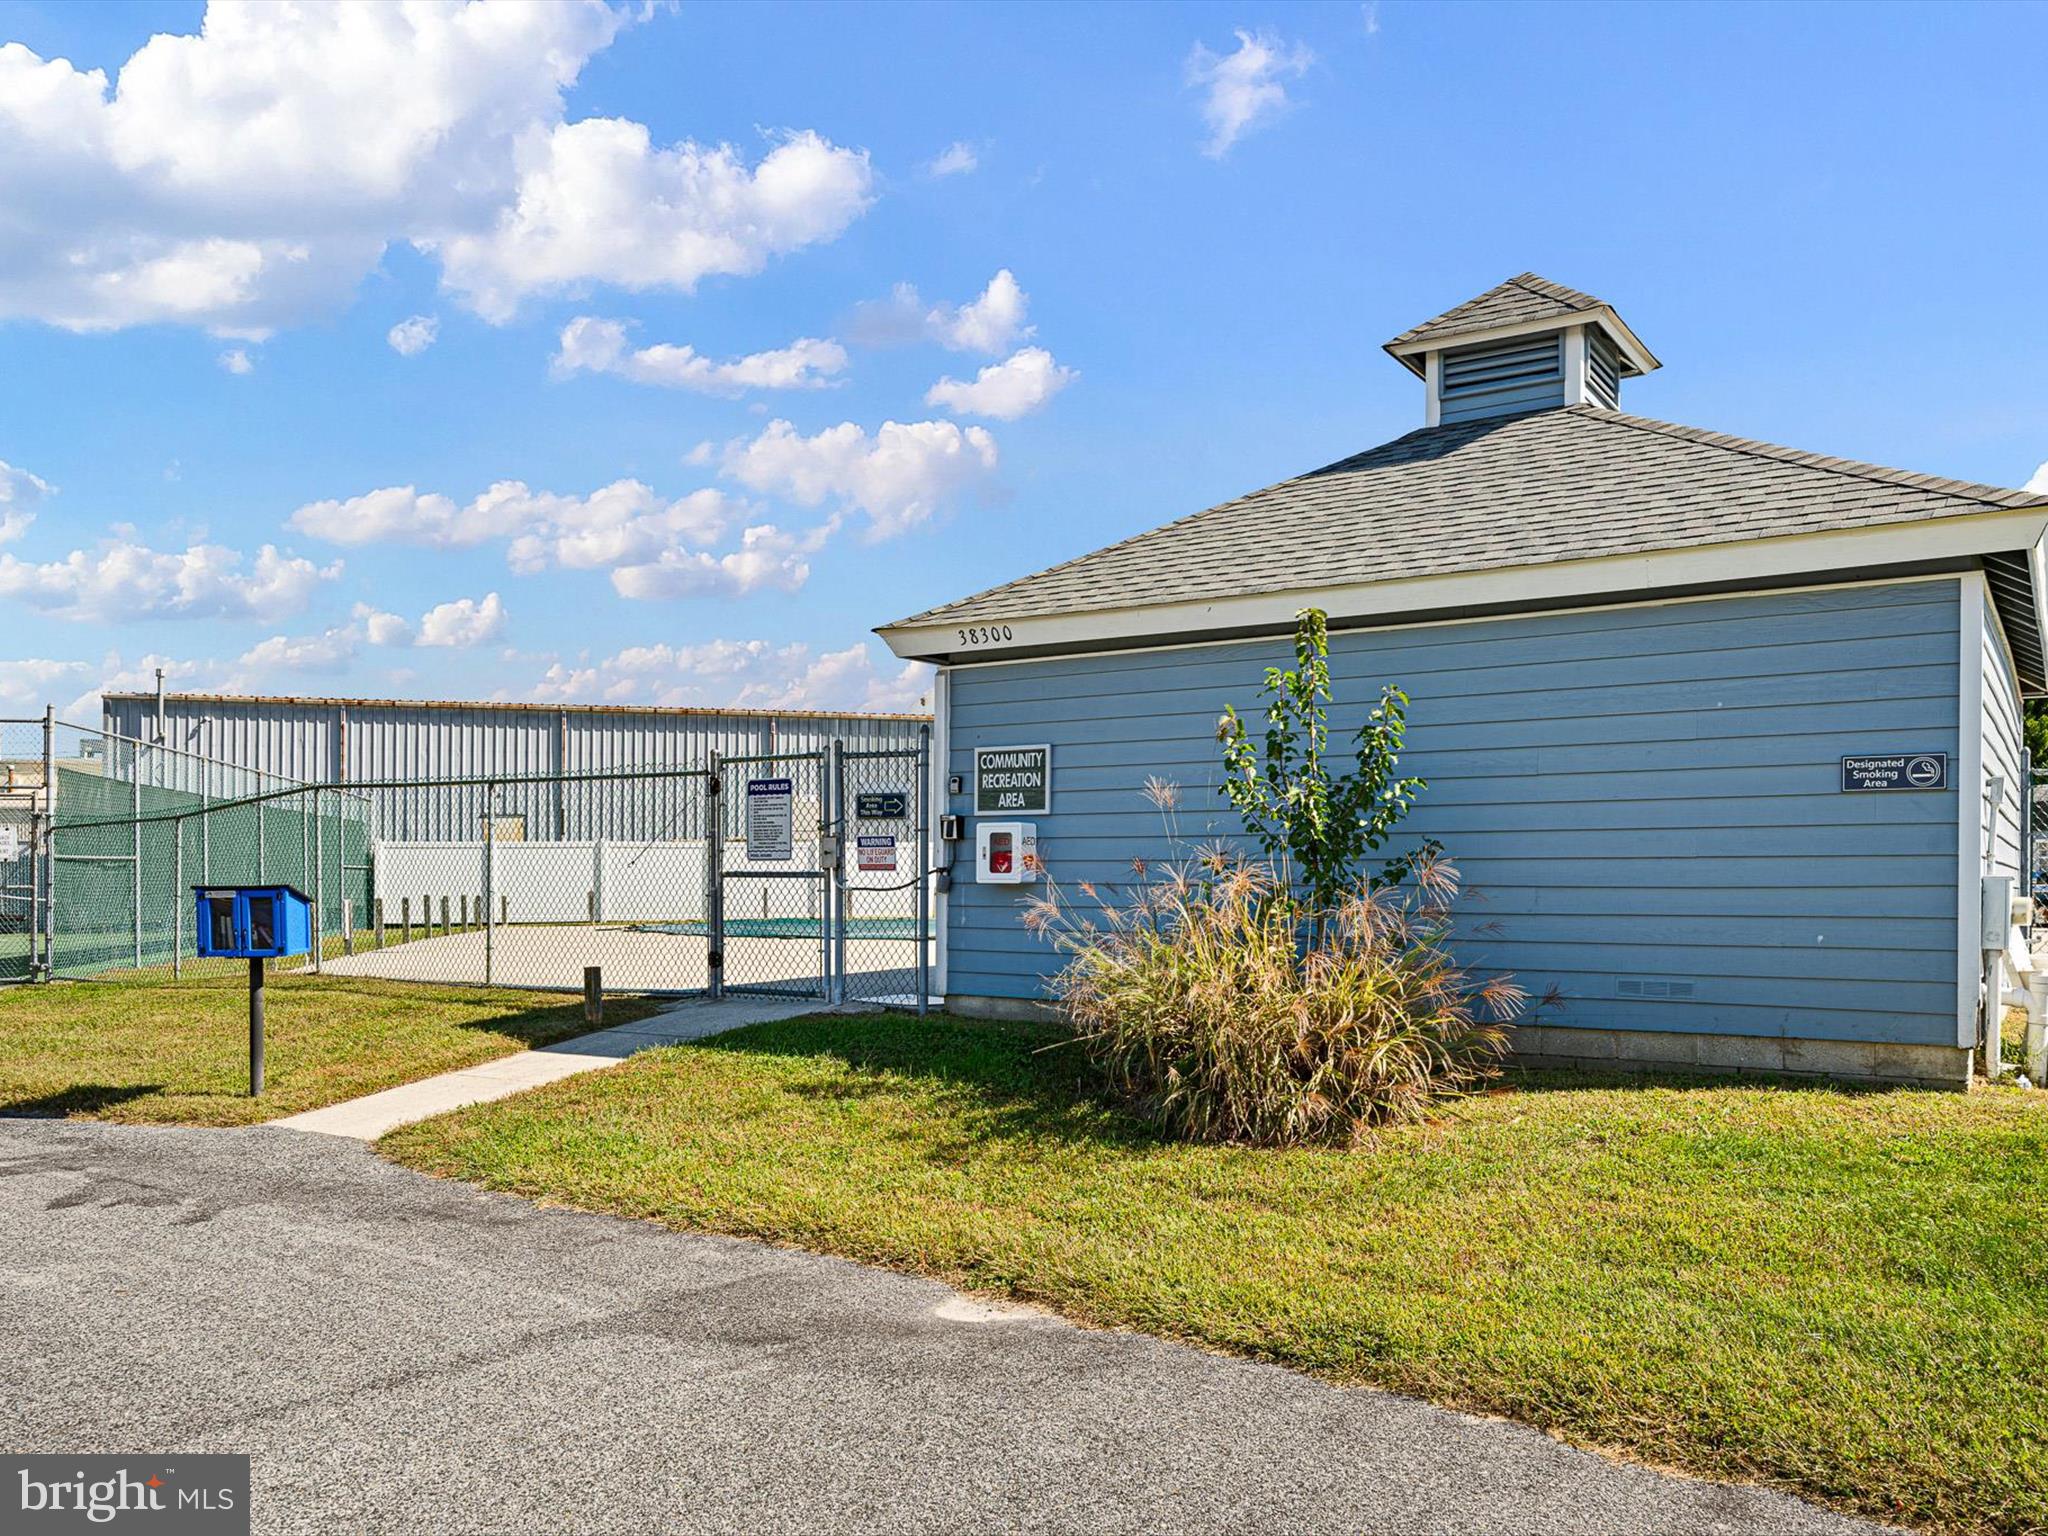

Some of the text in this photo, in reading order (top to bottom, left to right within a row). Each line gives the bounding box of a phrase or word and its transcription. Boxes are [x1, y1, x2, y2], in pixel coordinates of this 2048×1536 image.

[958, 625, 1012, 646] 38300
[980, 752, 1042, 769] COMMUNITY
[1846, 758, 1905, 770] Designated
[982, 772, 1041, 789] RECREATION
[1853, 770, 1898, 780] Smoking
[768, 783, 789, 791] RULES
[860, 796, 883, 804] Smoking
[998, 793, 1025, 807] AREA
[860, 837, 892, 846] WARNING
[1021, 836, 1036, 846] AED
